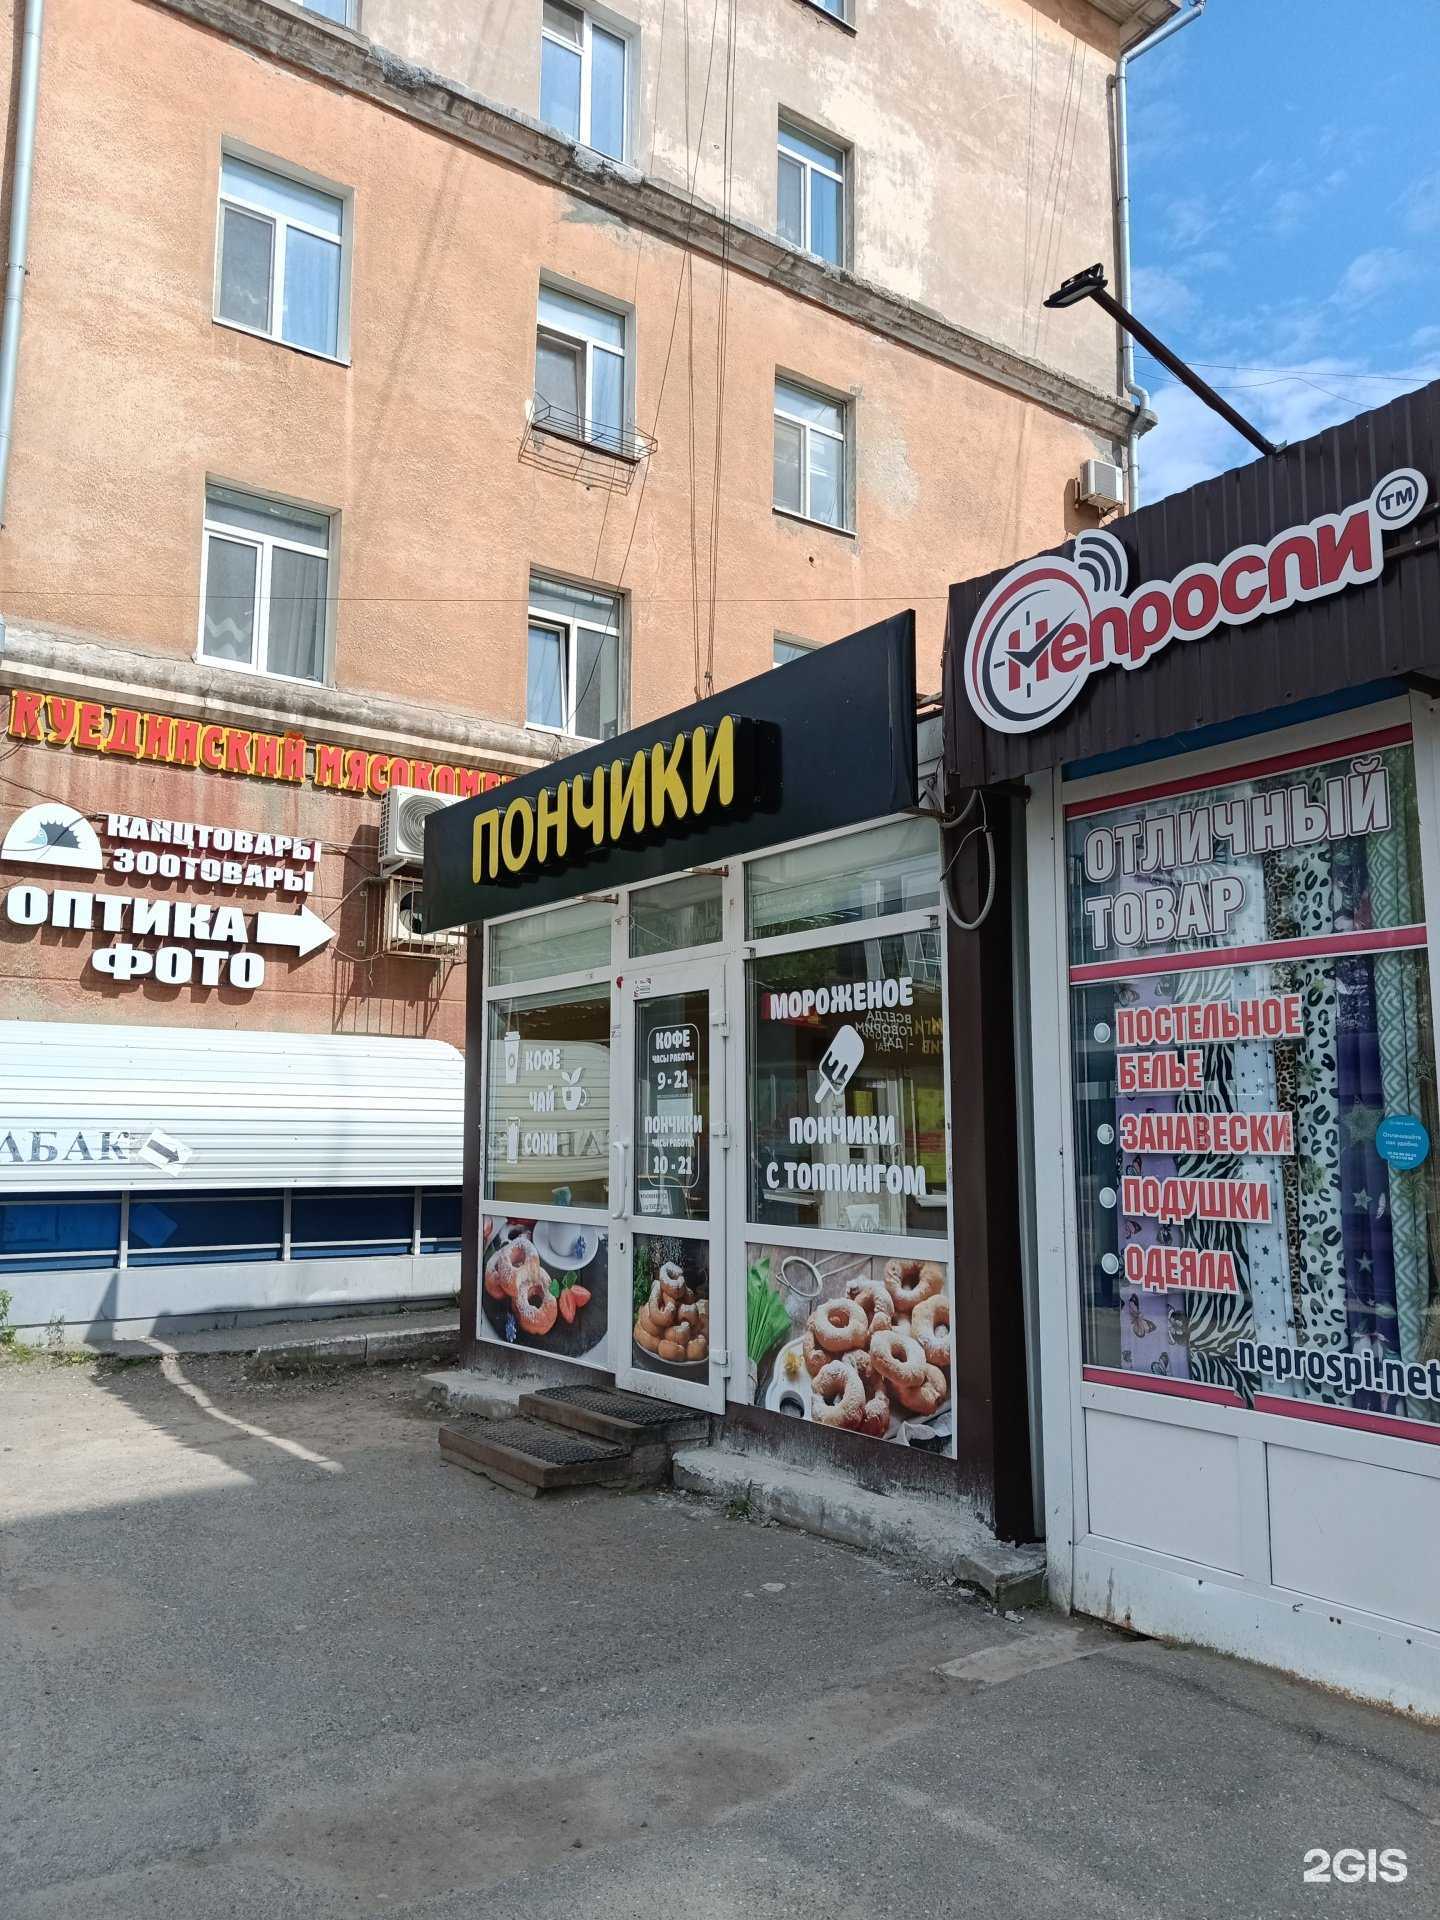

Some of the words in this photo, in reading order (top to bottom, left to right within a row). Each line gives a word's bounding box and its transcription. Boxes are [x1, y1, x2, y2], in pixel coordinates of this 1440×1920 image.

[9, 690, 307, 784] КУЕДИНСКИЙ
[315, 743, 519, 797] МЯСОКОМ
[472, 715, 734, 883] ПОНЧИКИ
[1085, 755, 1391, 882] ОТЛИЧНЫЙ
[107, 813, 322, 863] КАНЦТОВАРЫ
[113, 848, 315, 893] ЗООТОВАРЫ
[7, 885, 249, 943] ОПТИКА
[1086, 876, 1246, 951] ТОВАР
[92, 942, 265, 989] ФОТО
[770, 976, 914, 1020] МОРОЖЕНОЕ
[1116, 994, 1304, 1046] ПОСТЕЛЬНОЕ
[525, 1049, 561, 1072] КОФЕ
[652, 1054, 669, 1064] ЧАСЫ
[669, 1051, 695, 1062] РАБОТЫ
[655, 1029, 691, 1050] КОФЕ
[1117, 1049, 1204, 1092] БЕЛЬЕ
[529, 1085, 555, 1112] ЧАЙ
[524, 1132, 558, 1155] СОКИ
[644, 1114, 703, 1134] ПОНЧИКИ
[789, 1115, 896, 1145] ПОНЧИКИ
[1119, 1111, 1294, 1155] ЗАНАВЕСКИ
[766, 1162, 780, 1189] С
[783, 1162, 926, 1195] ТОППИНГОМ
[1121, 1176, 1273, 1224] ПОДУШКИ
[1124, 1244, 1240, 1294] ОДЕЯЛА
[1237, 1339, 1440, 1401] neprospi.net
